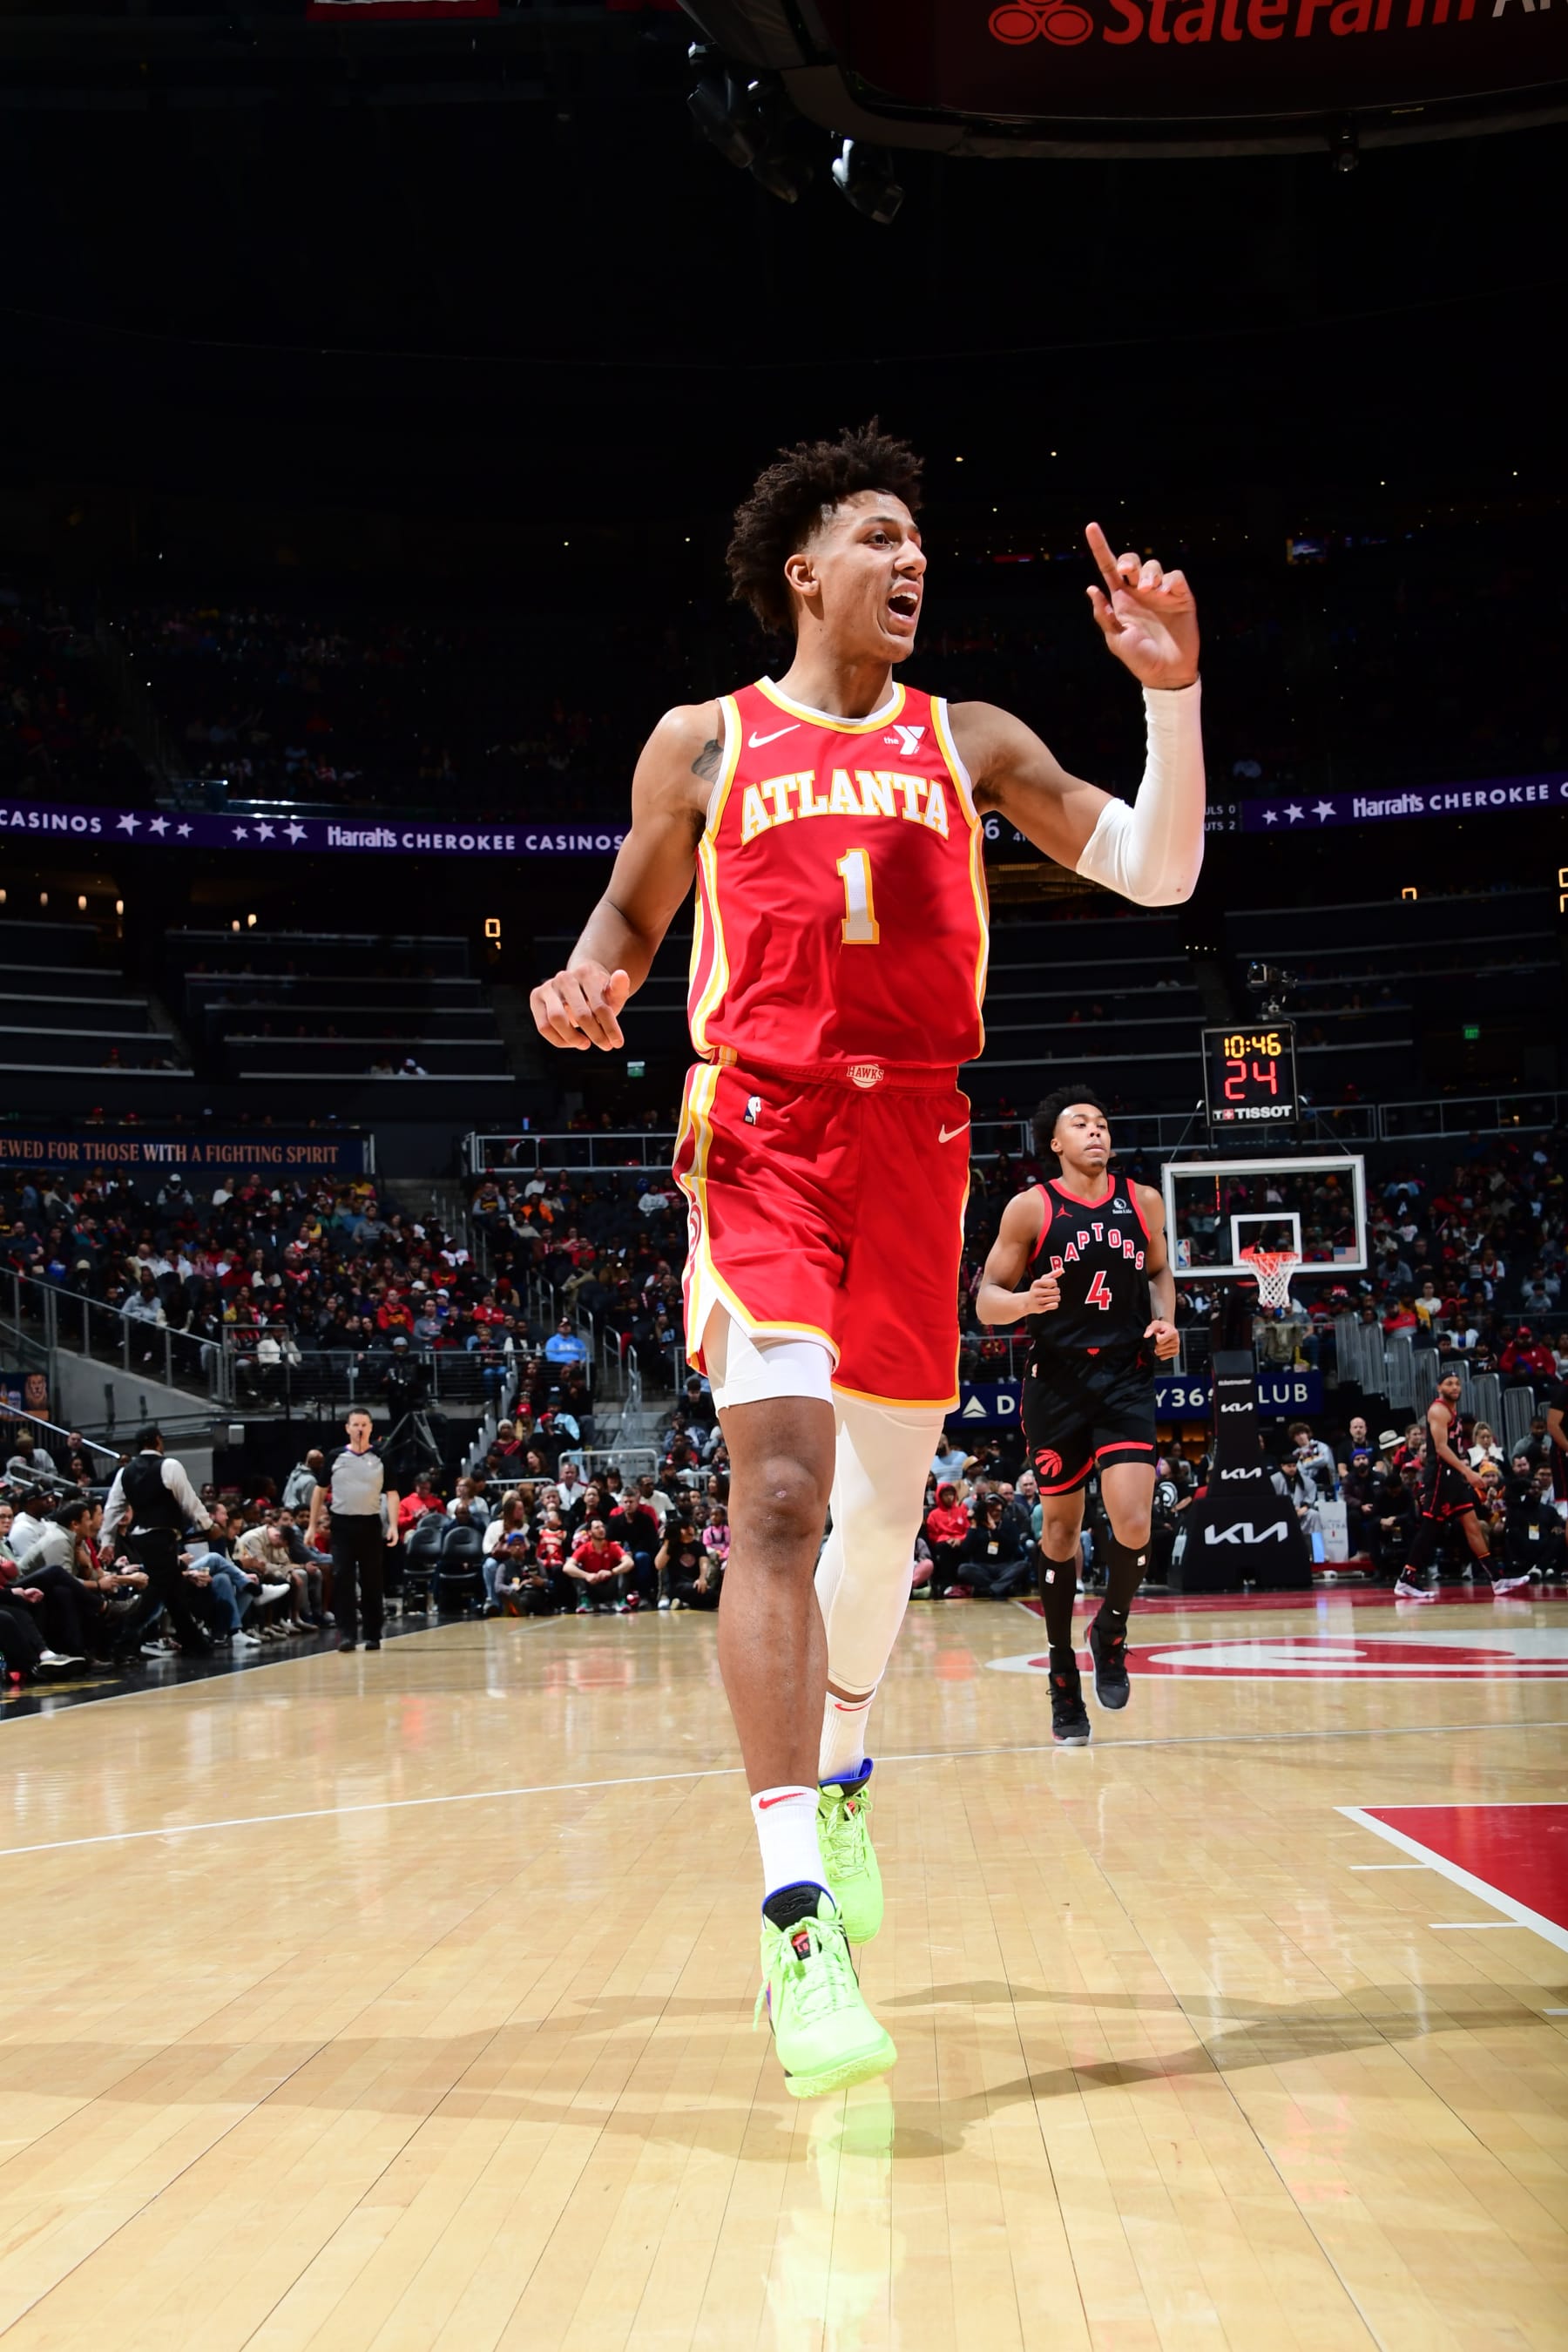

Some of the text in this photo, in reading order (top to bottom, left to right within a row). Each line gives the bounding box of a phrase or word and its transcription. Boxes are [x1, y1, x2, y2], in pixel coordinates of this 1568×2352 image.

[740, 768, 950, 847] ATLANTA
[1429, 784, 1550, 810] CHEROKEE
[984, 819, 1000, 840] 6
[1228, 821, 1236, 830] 2
[402, 833, 516, 851] CHEROKEE
[525, 835, 625, 851] CASINOS
[836, 848, 880, 945] 1
[1224, 1033, 1281, 1058] 10:46
[847, 1065, 885, 1081] HAWKS
[1224, 1060, 1278, 1100] 24
[1234, 1105, 1293, 1119] TISSOT
[48, 1141, 79, 1159] FOR
[83, 1143, 139, 1161] THOSE
[143, 1144, 187, 1162] WITH
[192, 1145, 202, 1162] A
[206, 1145, 282, 1164] FIGHTING
[286, 1146, 340, 1164] SPIRIT
[1050, 1222, 1145, 1271] RAPTORS
[1085, 1270, 1112, 1311] 4
[1258, 1383, 1308, 1403] LUB
